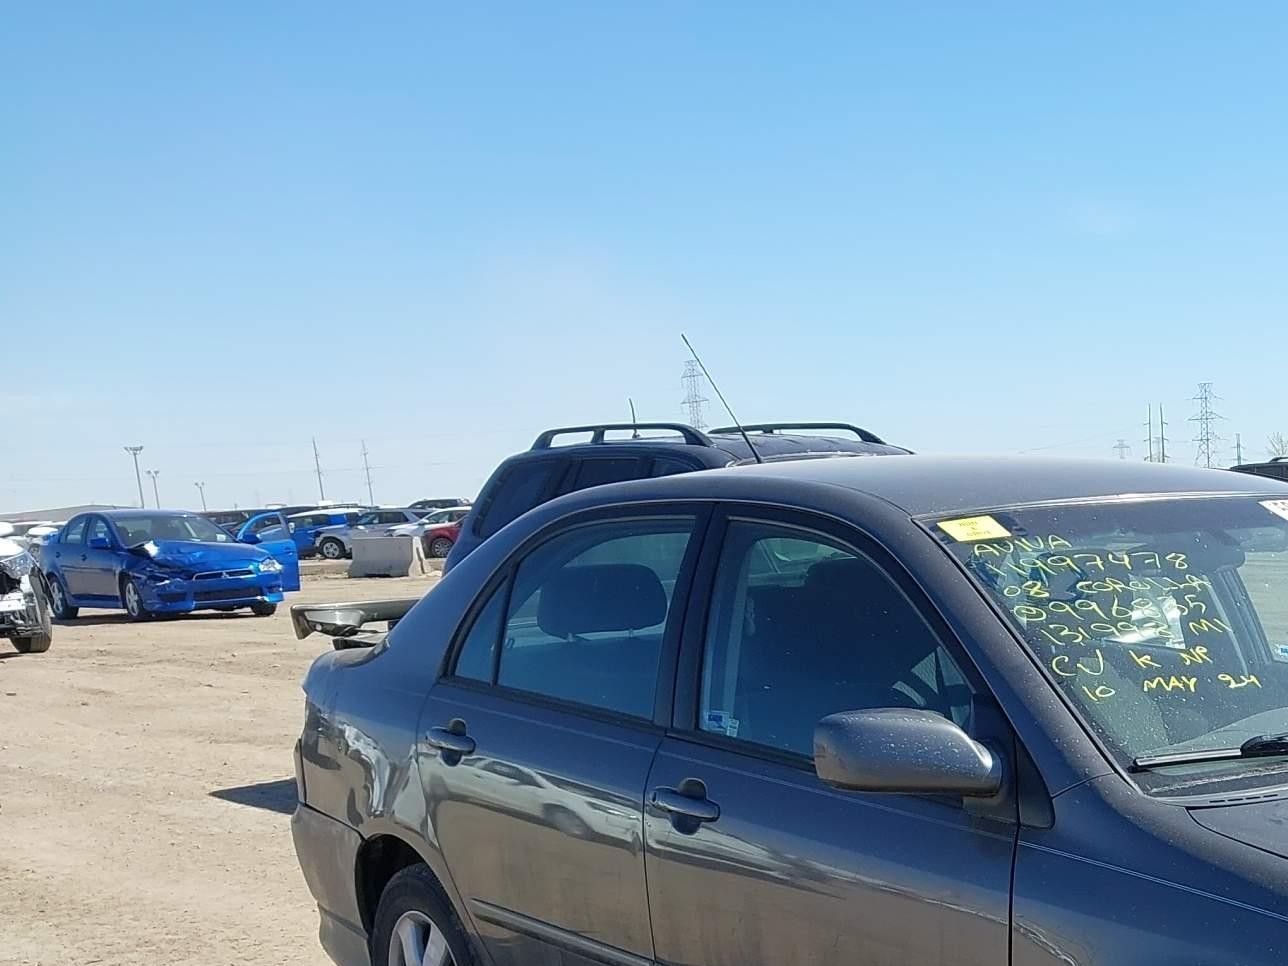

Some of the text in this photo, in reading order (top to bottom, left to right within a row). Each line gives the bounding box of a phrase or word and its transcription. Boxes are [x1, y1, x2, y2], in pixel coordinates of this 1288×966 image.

[985, 552, 1187, 577] 11997478
[1003, 580, 1050, 598] 08
[1082, 673, 1263, 701] 10 MAY 24
